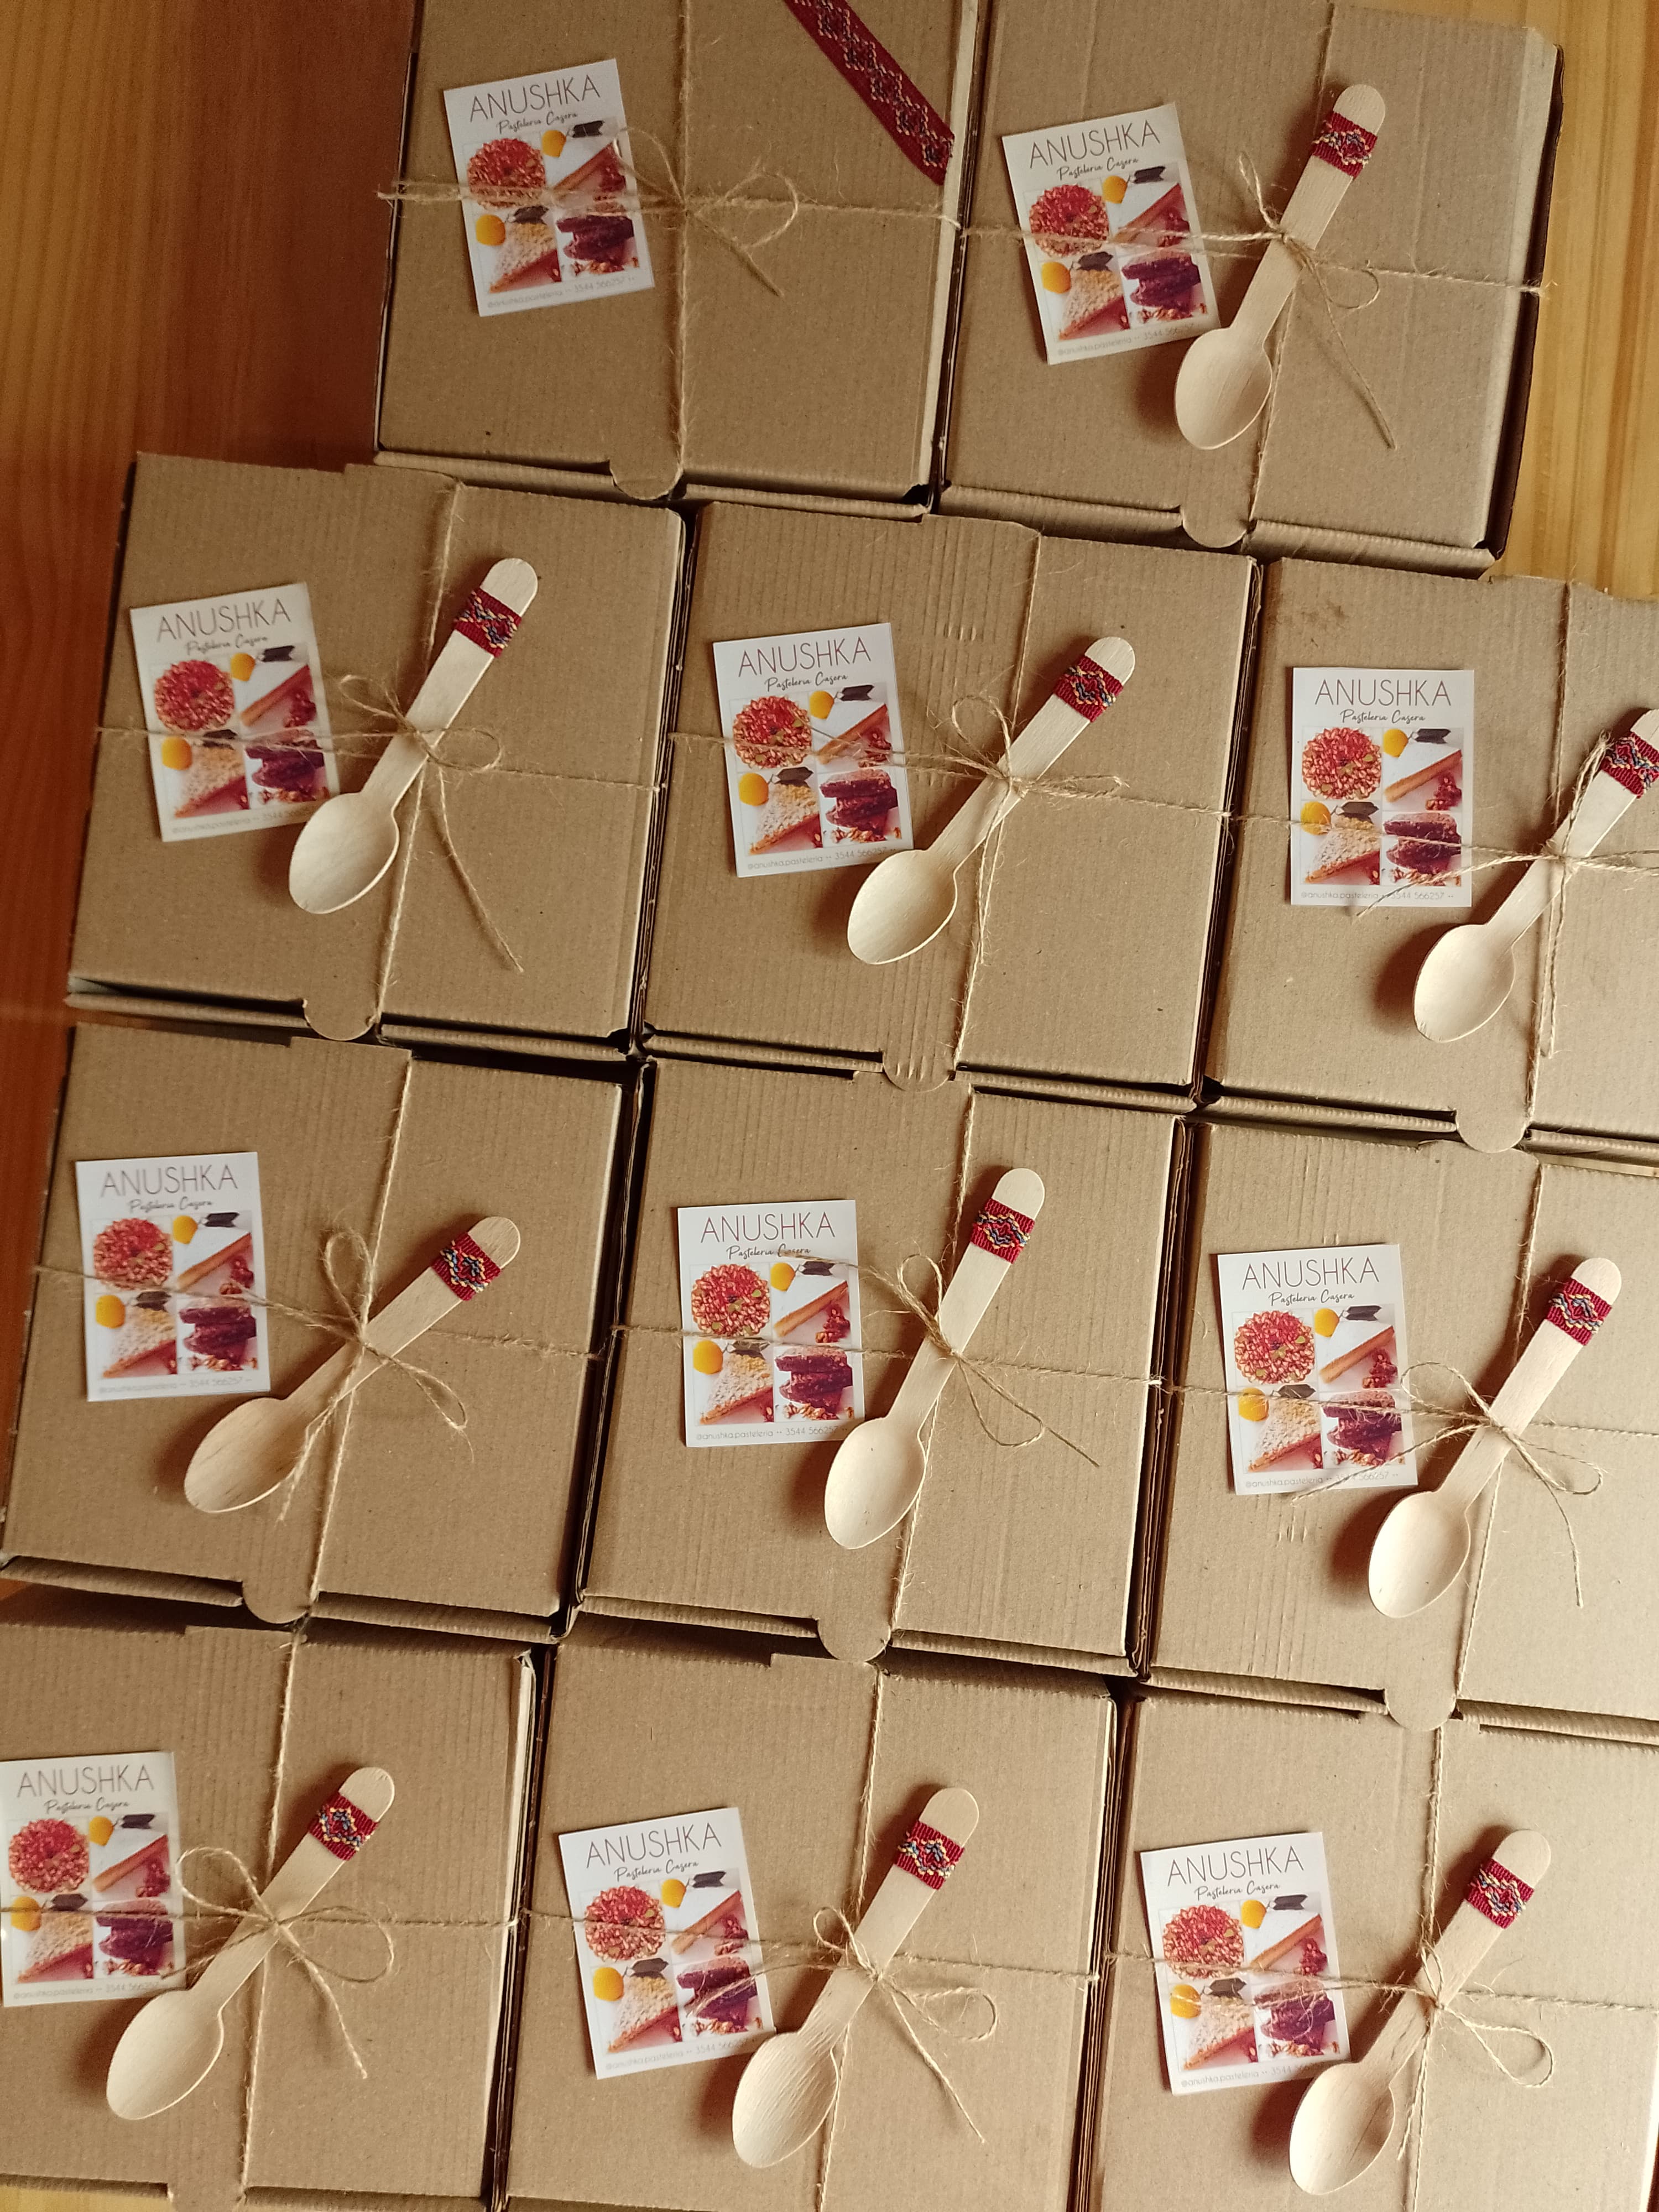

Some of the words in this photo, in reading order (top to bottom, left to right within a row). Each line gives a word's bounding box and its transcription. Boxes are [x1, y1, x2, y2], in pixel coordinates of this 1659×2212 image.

[469, 75, 600, 123] ANUSHKA
[545, 111, 577, 125] Casera
[1029, 119, 1160, 169] ANUSHKA
[1106, 157, 1138, 171] Casera
[157, 598, 290, 641] ANUSHKA
[738, 637, 871, 677] ANUSHKA
[815, 671, 848, 686] Casera
[1314, 679, 1451, 706] ANUSHKA
[1391, 709, 1425, 724] Casera
[835, 850, 854, 860] 3544
[1414, 891, 1444, 900] 566257
[100, 1164, 237, 1197] ANUSHKA
[700, 1212, 834, 1243] ANUSHKA
[1241, 1256, 1379, 1290] ANUSHKA
[1320, 1288, 1354, 1303] Casera
[786, 1427, 805, 1436] 3544
[17, 1765, 154, 1797] ANUSHKA
[586, 1822, 721, 1868] ANUSHKA
[665, 1859, 698, 1874] Casera
[1167, 1845, 1303, 1886] ANUSHKA
[1246, 1880, 1280, 1895] Casera
